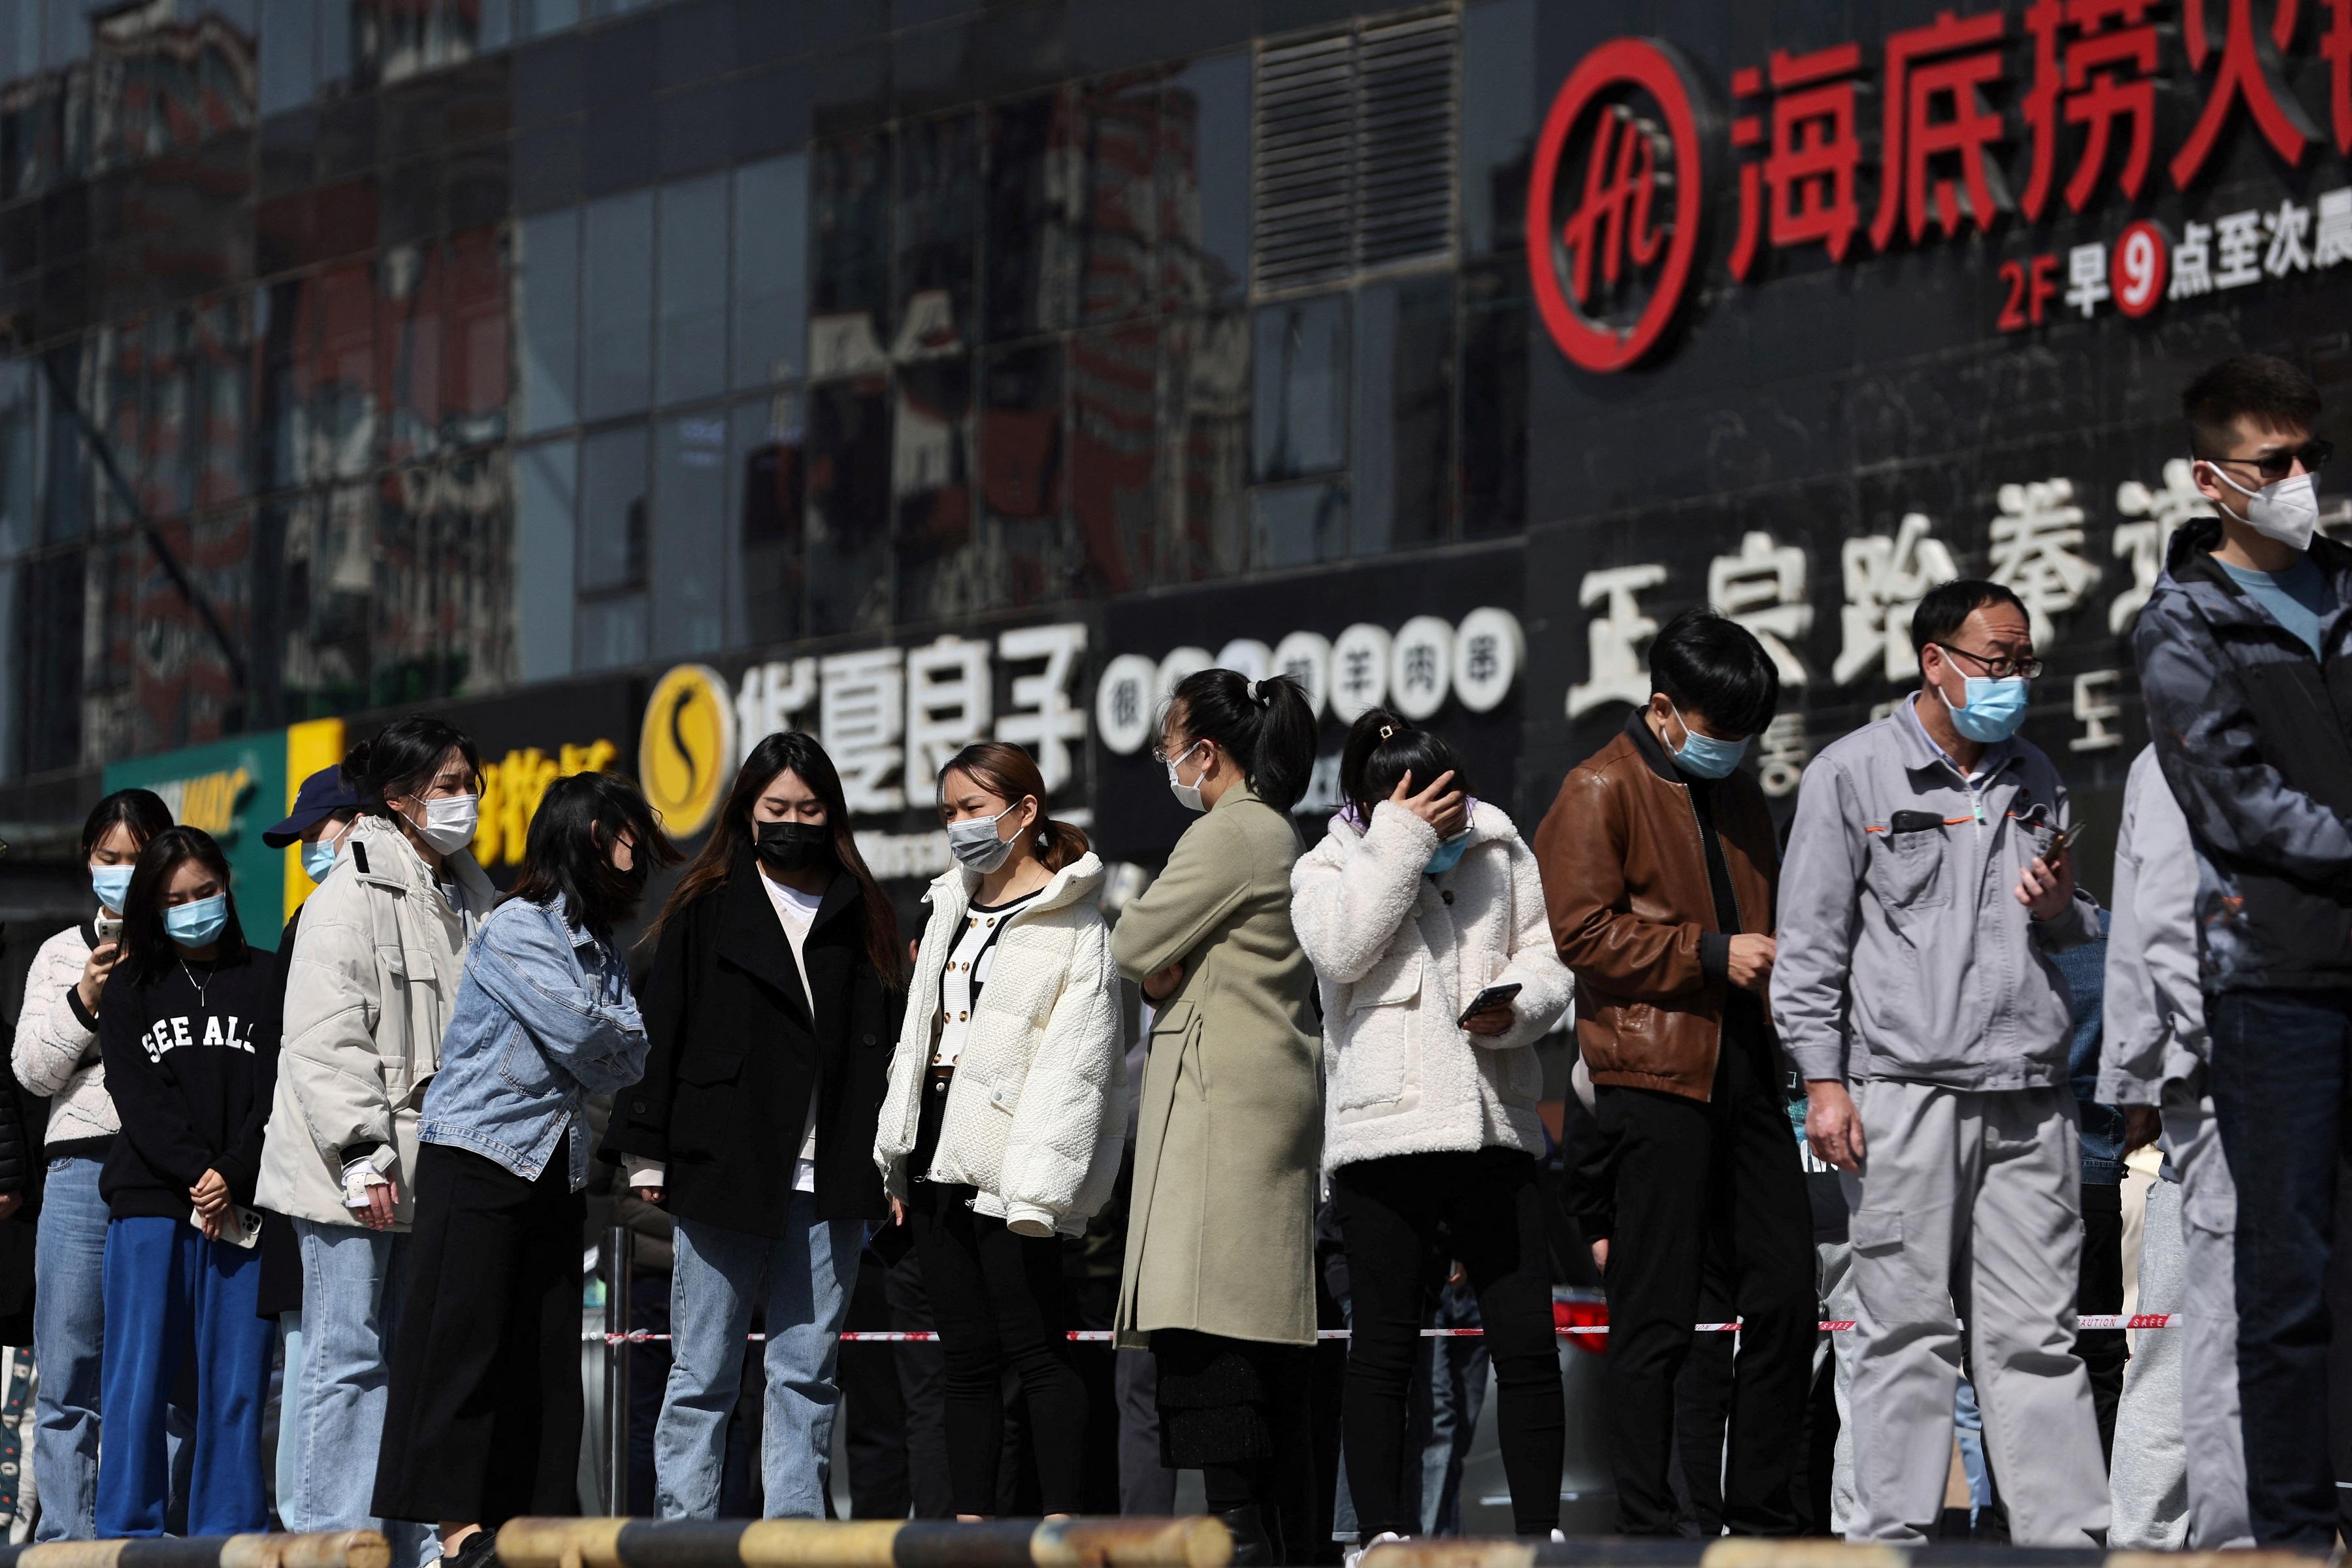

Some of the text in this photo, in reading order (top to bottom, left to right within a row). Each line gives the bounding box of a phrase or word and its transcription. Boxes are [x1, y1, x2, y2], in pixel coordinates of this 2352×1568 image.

[1997, 253, 2058, 331] 2F
[141, 1016, 193, 1064] SEE
[1821, 1322, 1850, 1330] SAFE
[2077, 1318, 2163, 1328] AUTION SAFE
